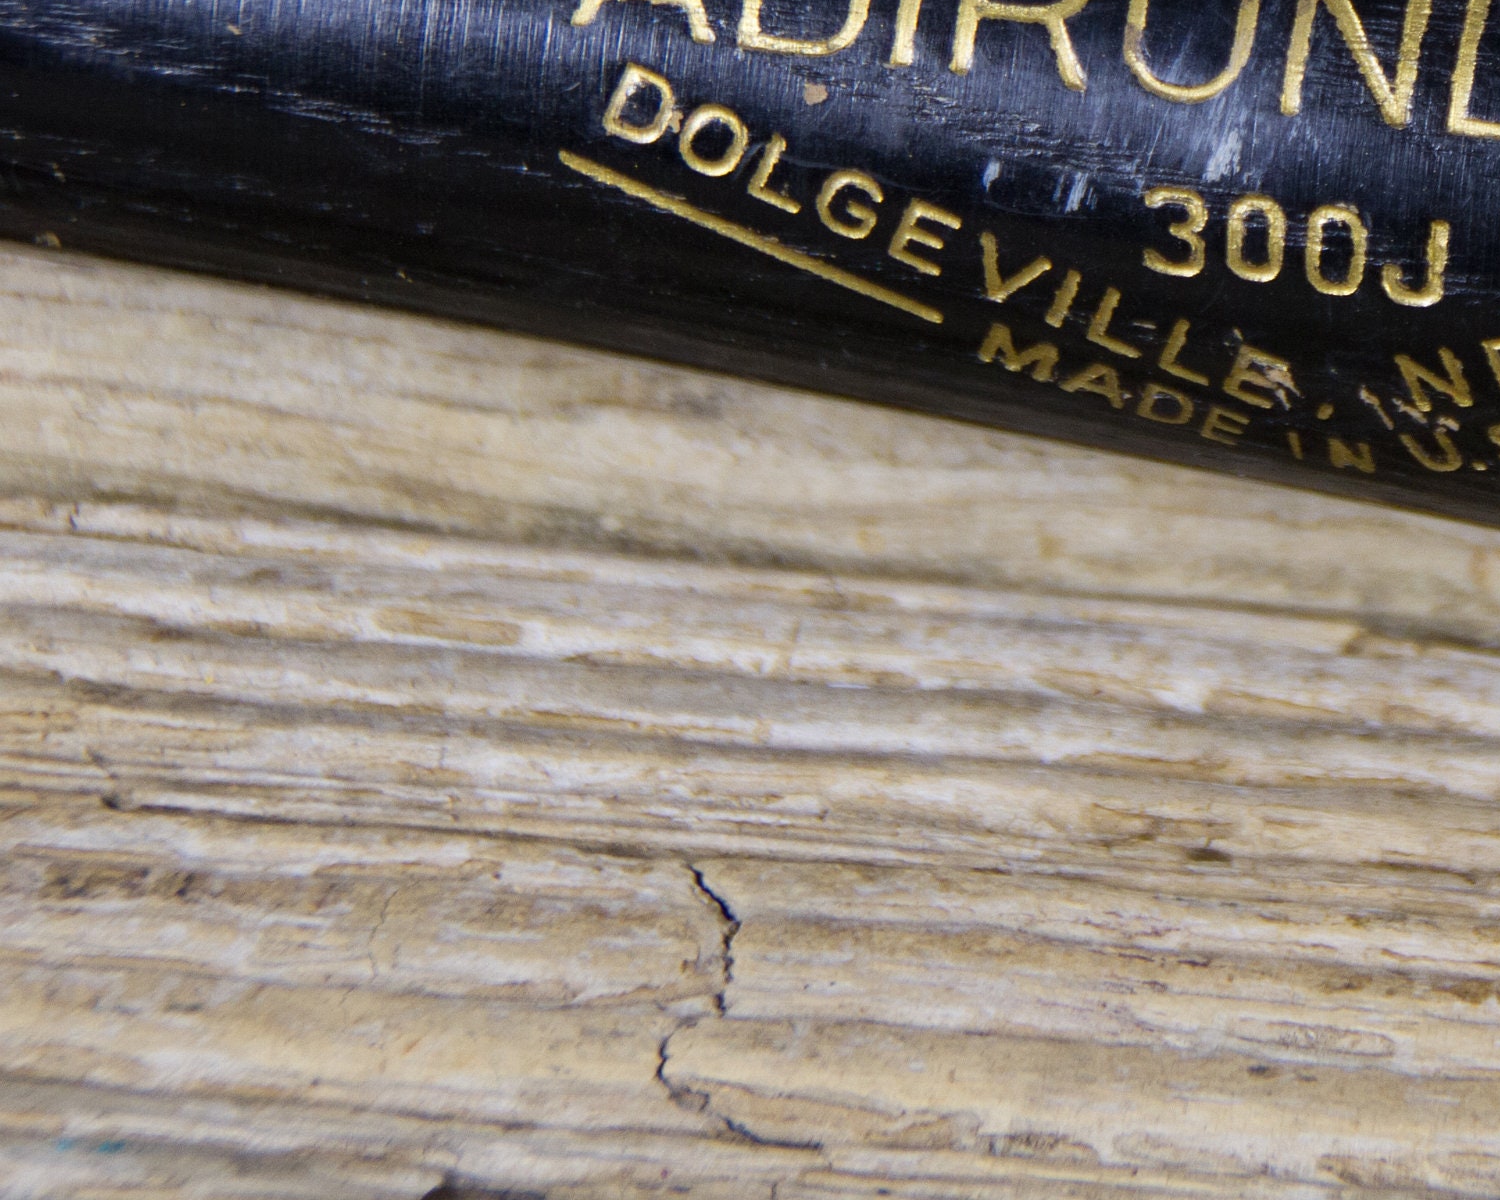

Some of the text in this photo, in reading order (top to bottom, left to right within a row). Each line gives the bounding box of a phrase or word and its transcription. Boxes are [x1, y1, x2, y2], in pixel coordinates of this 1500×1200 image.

[1142, 185, 1451, 307] 300J
[977, 322, 1251, 447] MADE
[1286, 430, 1377, 475] IN
